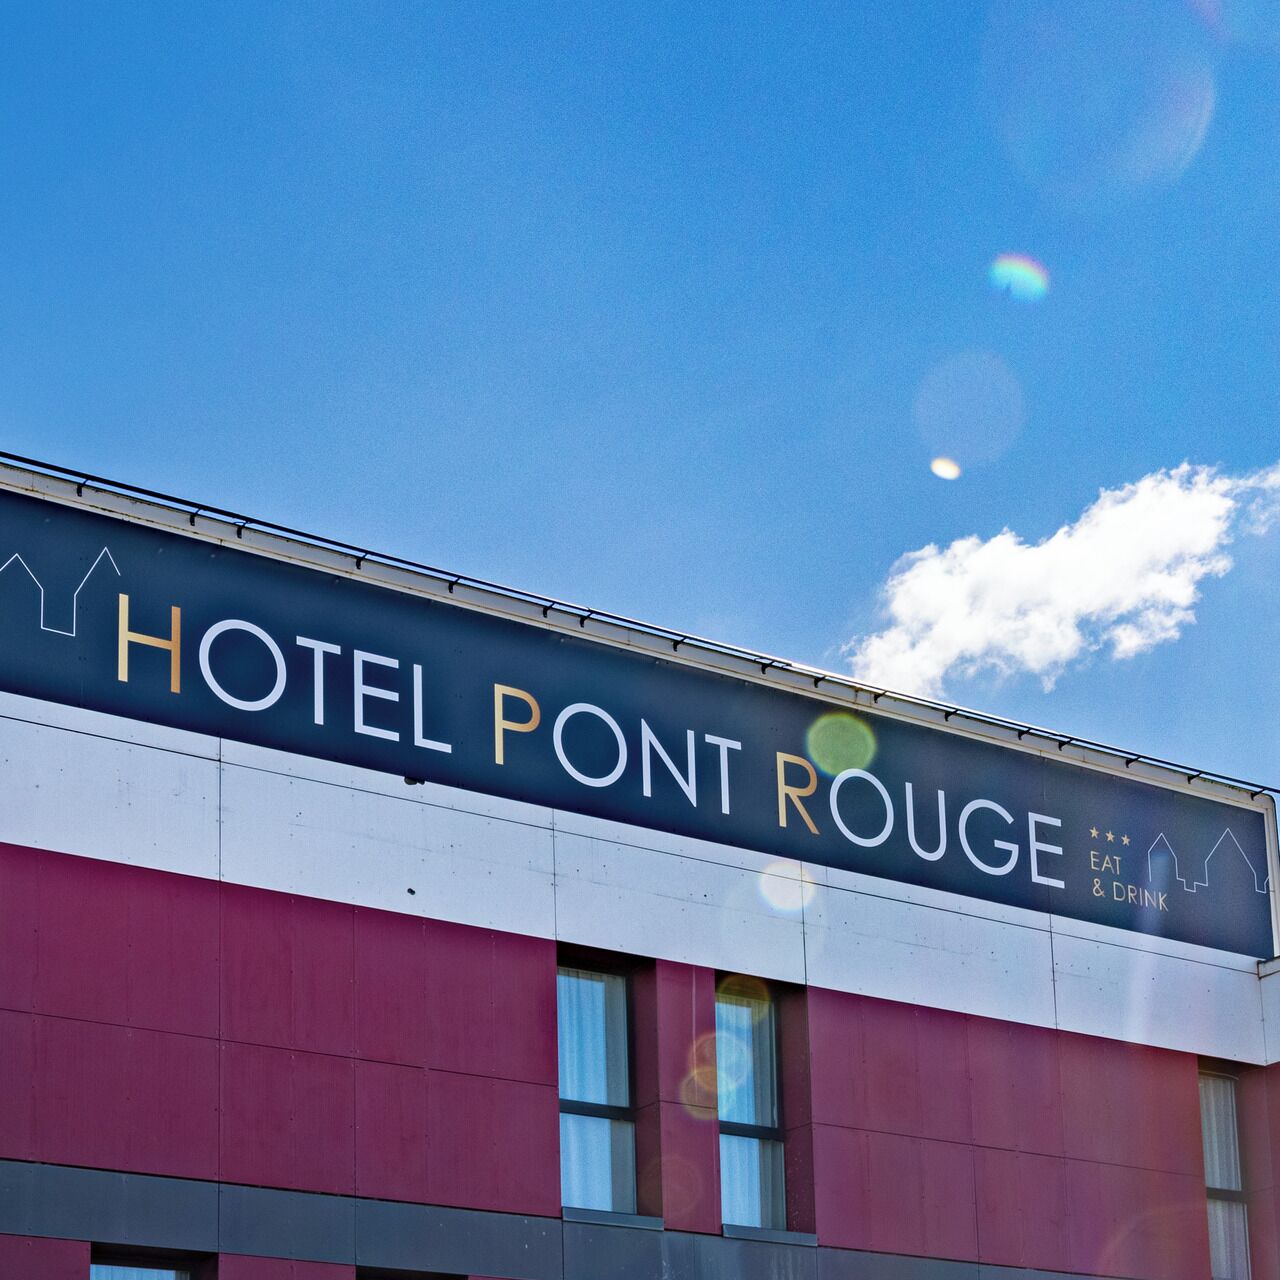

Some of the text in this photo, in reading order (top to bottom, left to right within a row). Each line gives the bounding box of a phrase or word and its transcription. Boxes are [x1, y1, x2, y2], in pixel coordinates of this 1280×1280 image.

[117, 593, 1066, 890] HOTEL PONT ROUGE
[1089, 850, 1122, 876] EAT
[1092, 878, 1169, 912] & DRINK
